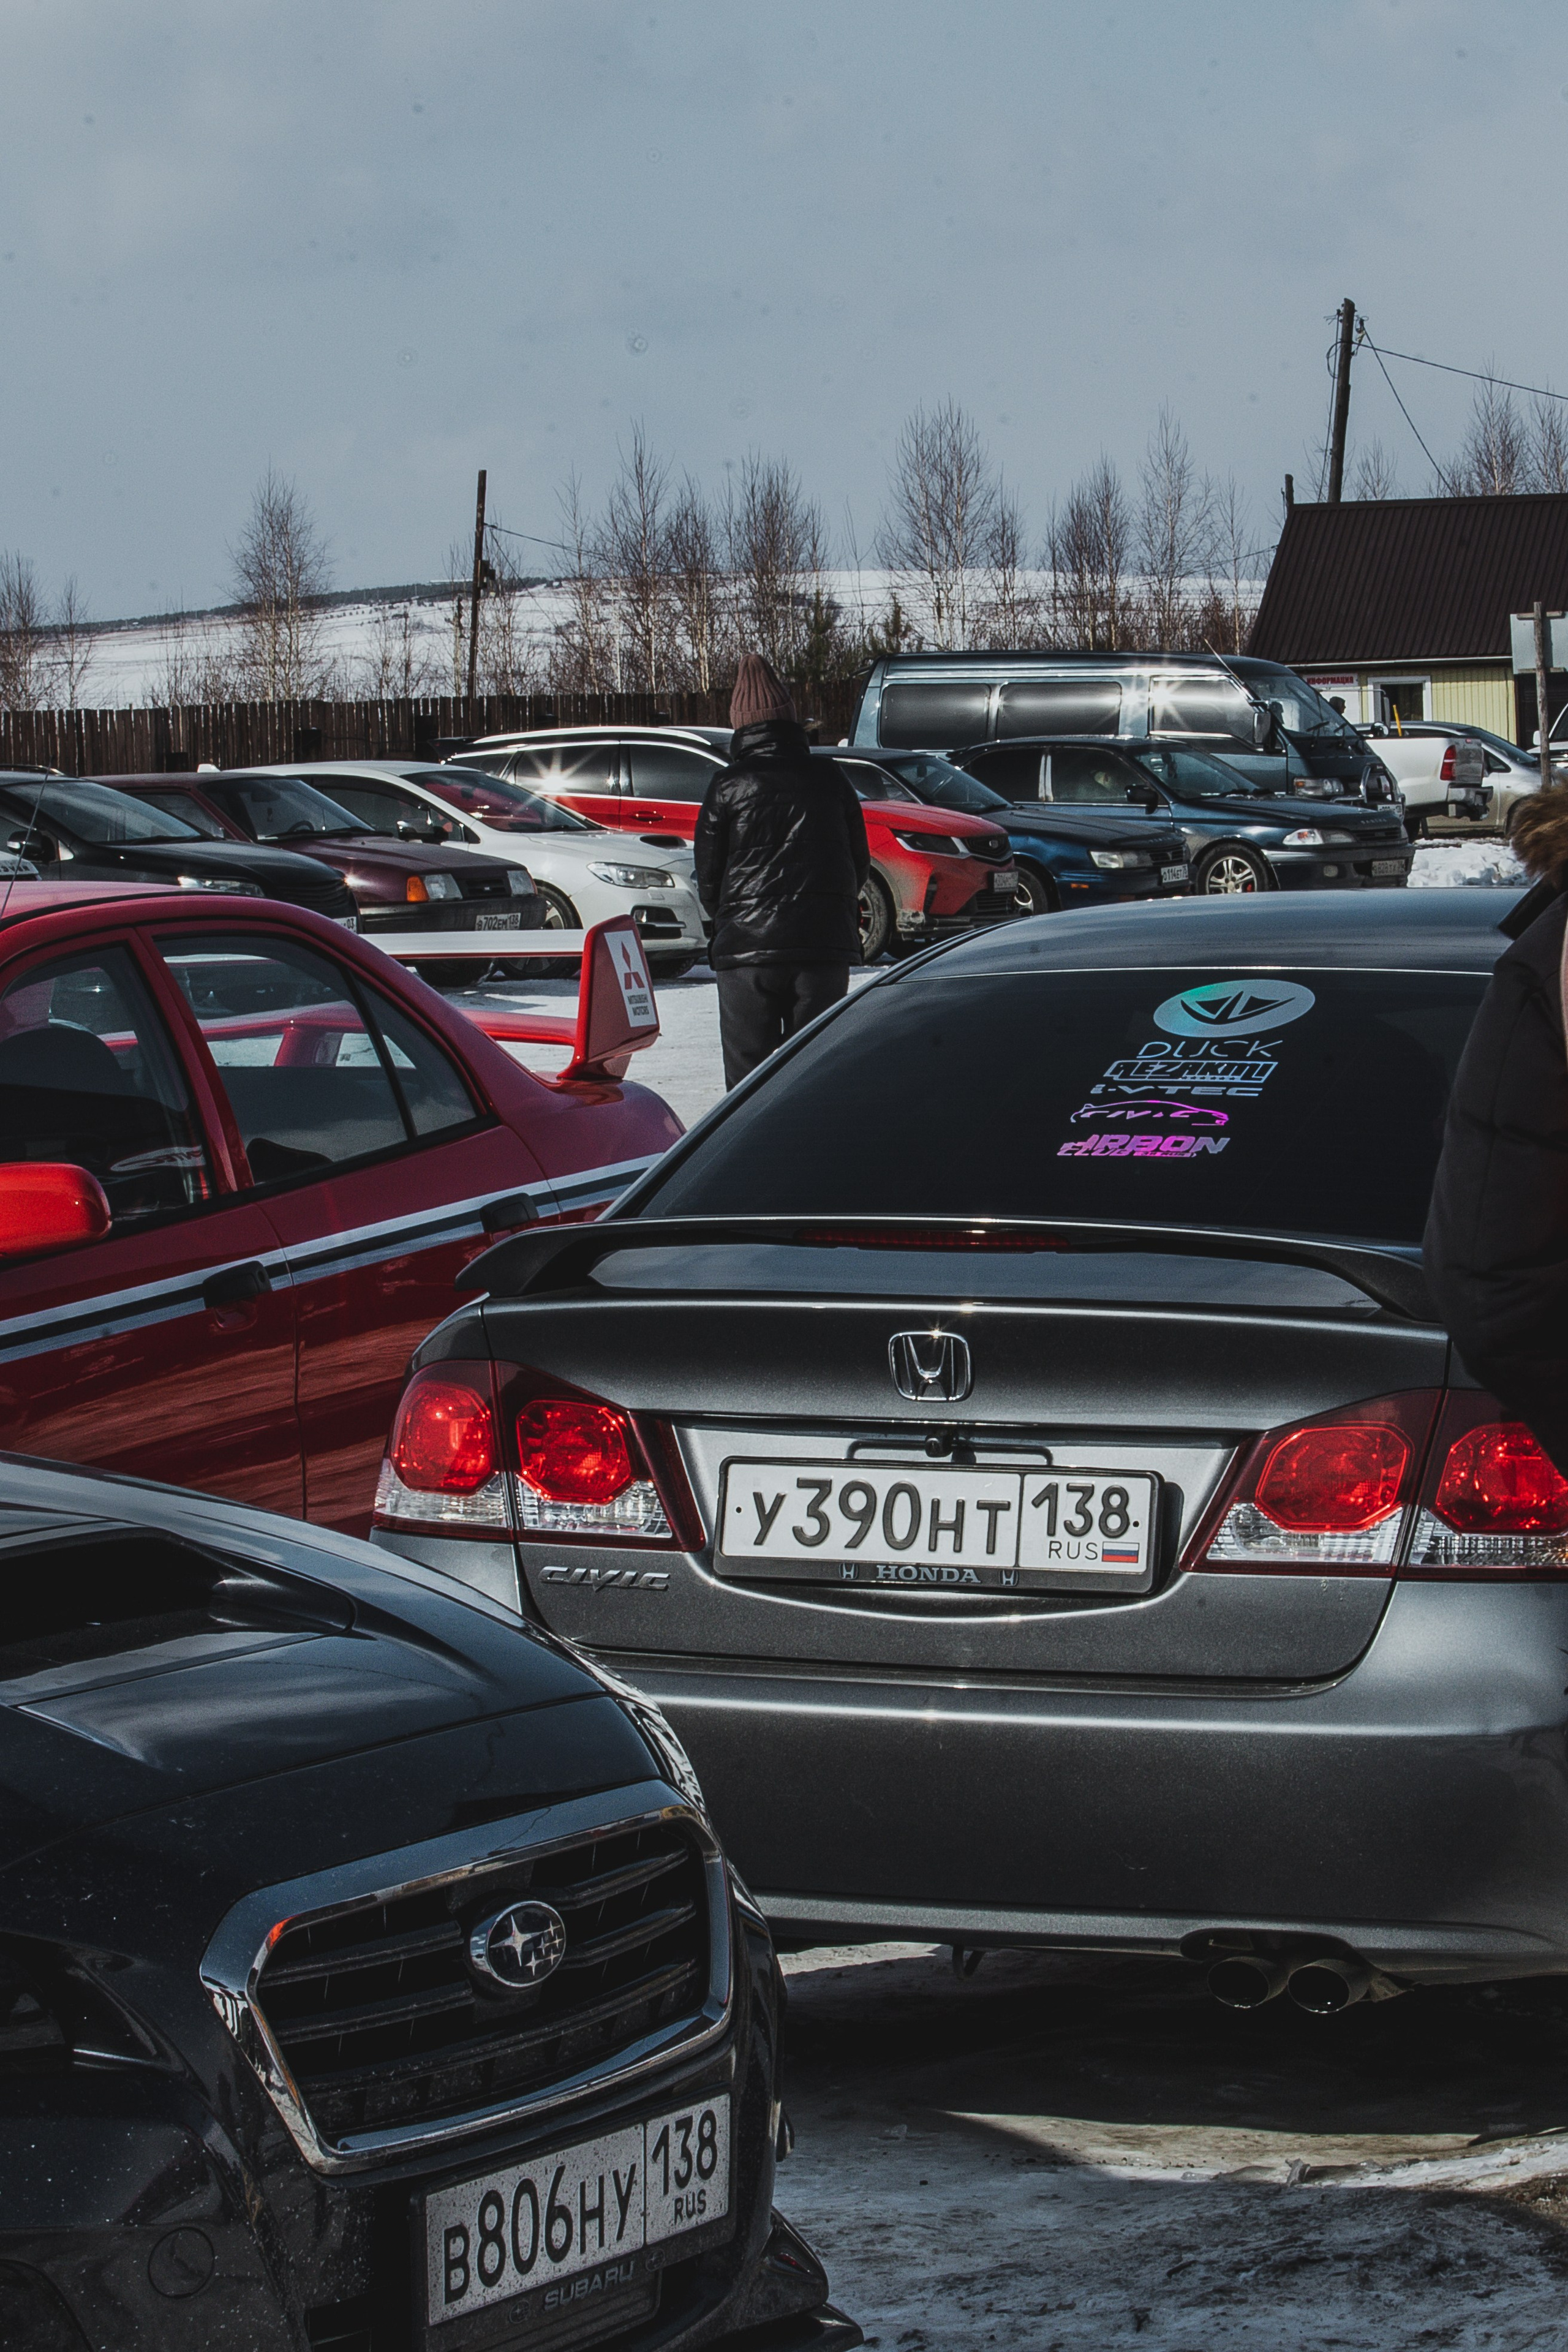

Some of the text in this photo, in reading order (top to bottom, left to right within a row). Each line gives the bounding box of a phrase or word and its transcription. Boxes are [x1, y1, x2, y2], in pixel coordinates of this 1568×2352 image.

[1306, 676, 1354, 685] ИНФОРМАЦИЯ
[1136, 1040, 1283, 1058] DUCK
[752, 1477, 1130, 1556] У390НТ 138
[1048, 1540, 1099, 1561] RUS
[538, 1566, 671, 1593] CIVIC
[876, 1564, 981, 1583] HONDA
[443, 2109, 718, 2305] В806НУ 138
[674, 2188, 707, 2225] RUS
[545, 2262, 634, 2309] SUBARU
